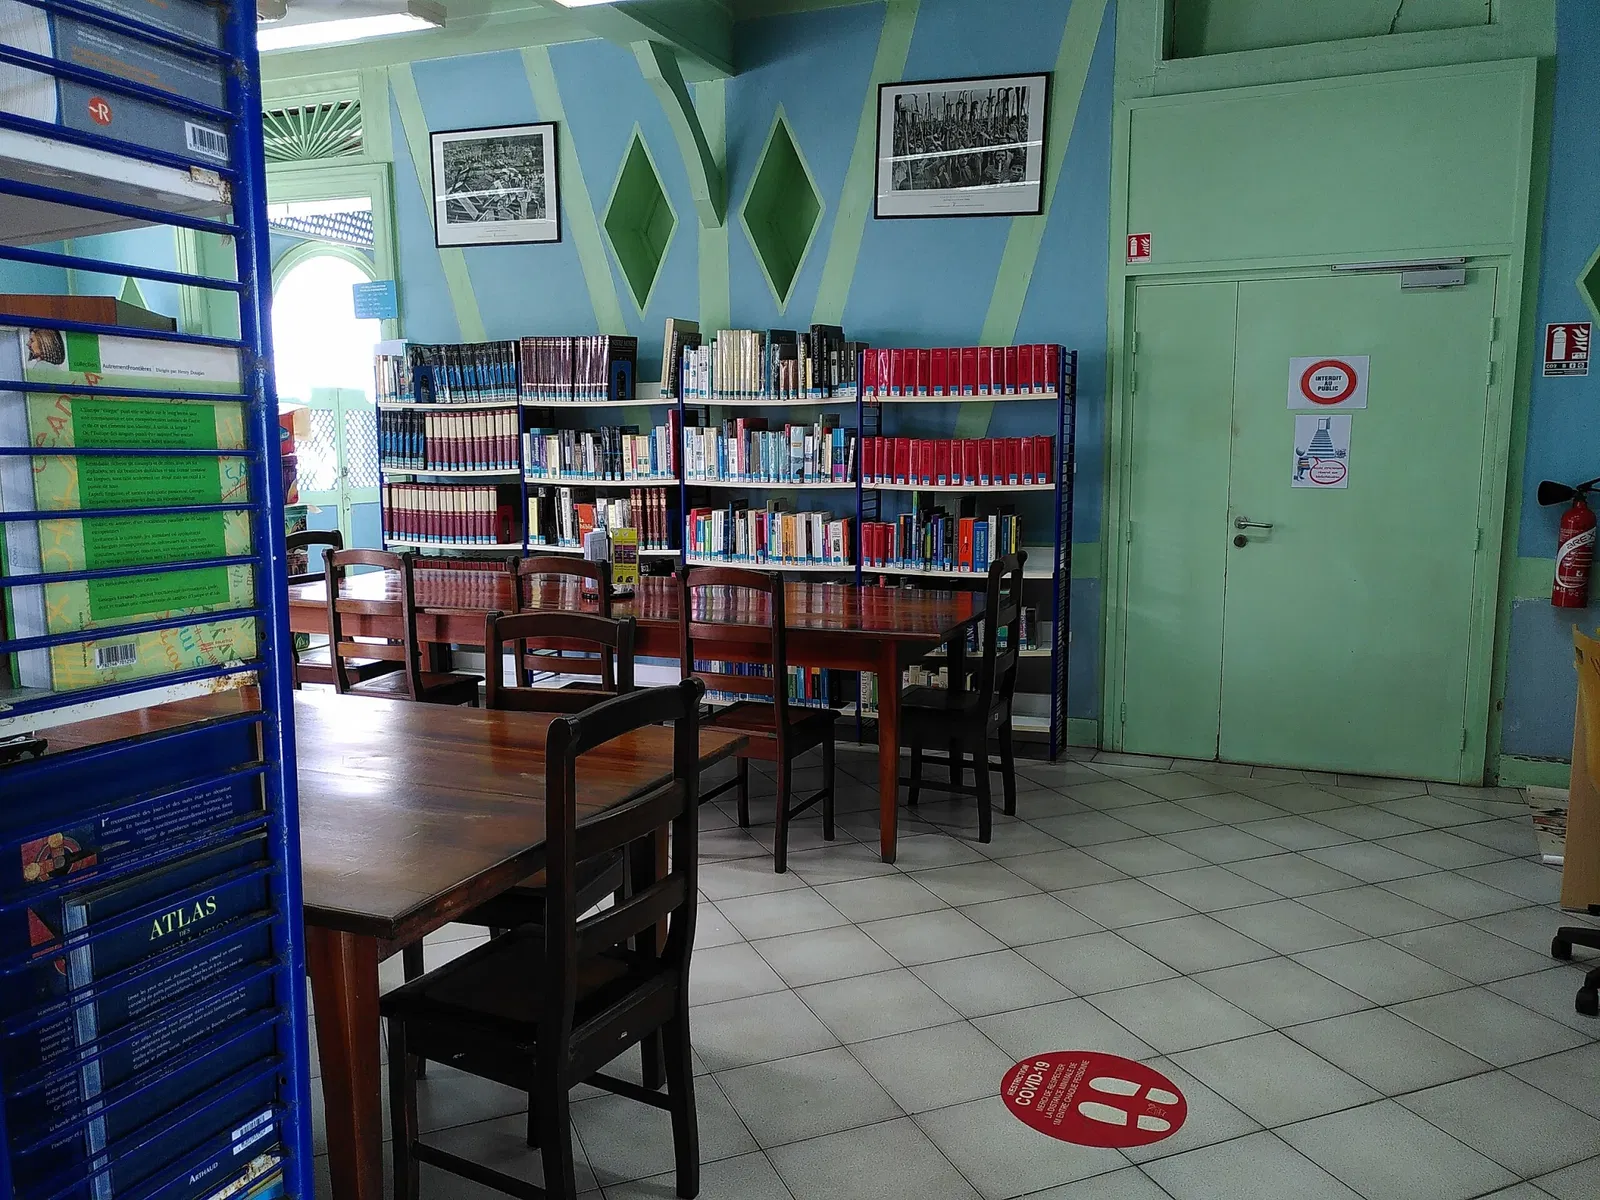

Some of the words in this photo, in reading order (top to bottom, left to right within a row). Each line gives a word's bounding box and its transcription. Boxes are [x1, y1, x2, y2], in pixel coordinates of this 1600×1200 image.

[149, 895, 217, 941] ATLAS
[178, 928, 191, 938] DES
[1007, 1064, 1029, 1096] RESTRICTION
[1015, 1061, 1050, 1105] COVID-19
[1046, 1088, 1063, 1111] DISTANCE
[1059, 1067, 1073, 1089] MINIMALE
[1047, 1063, 1065, 1089] RESPECTER
[1056, 1101, 1069, 1118] ENTRE
[1063, 1082, 1078, 1102] CHAQUE
[1073, 1059, 1089, 1083] PERSONNE
[1035, 1094, 1048, 1112] MERCI
[1043, 1088, 1052, 1096] DE
[188, 1161, 219, 1185] ARTHAUD
